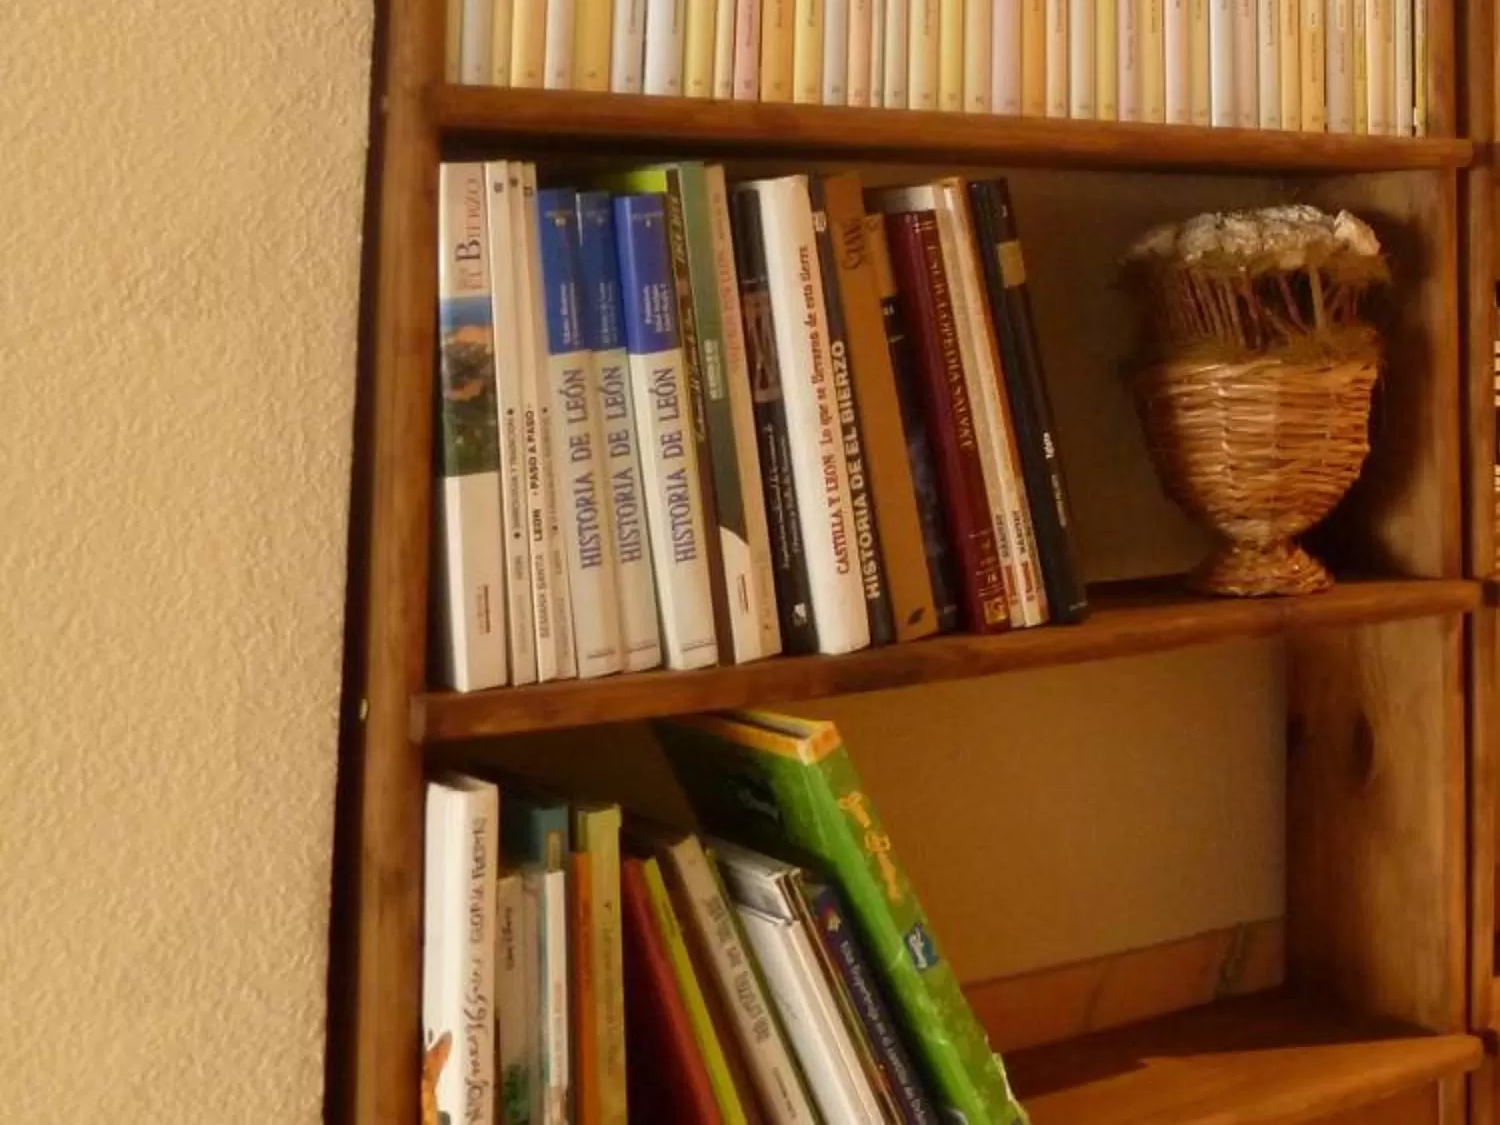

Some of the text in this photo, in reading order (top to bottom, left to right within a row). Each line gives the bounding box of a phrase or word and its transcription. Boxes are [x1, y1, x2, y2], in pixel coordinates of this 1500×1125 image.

[798, 245, 810, 282] tierra
[803, 284, 815, 310] esta
[804, 313, 817, 328] de
[558, 367, 588, 424] LEÓN
[599, 365, 626, 422] LEÓN
[649, 366, 680, 422] LEÓN
[815, 387, 827, 401] se
[818, 404, 833, 425] que
[570, 431, 592, 463] DE
[607, 428, 632, 459] DE
[660, 429, 685, 460] DE
[820, 428, 833, 445] Lo
[822, 453, 839, 493] LEON
[831, 340, 881, 600] HISTORIA DE EL BIERZO
[574, 471, 603, 570] HISTORIA
[612, 465, 643, 565] HISTORIA
[666, 466, 698, 566] HISTORIA
[827, 496, 840, 508] Y
[831, 508, 849, 575] CASTILLA
